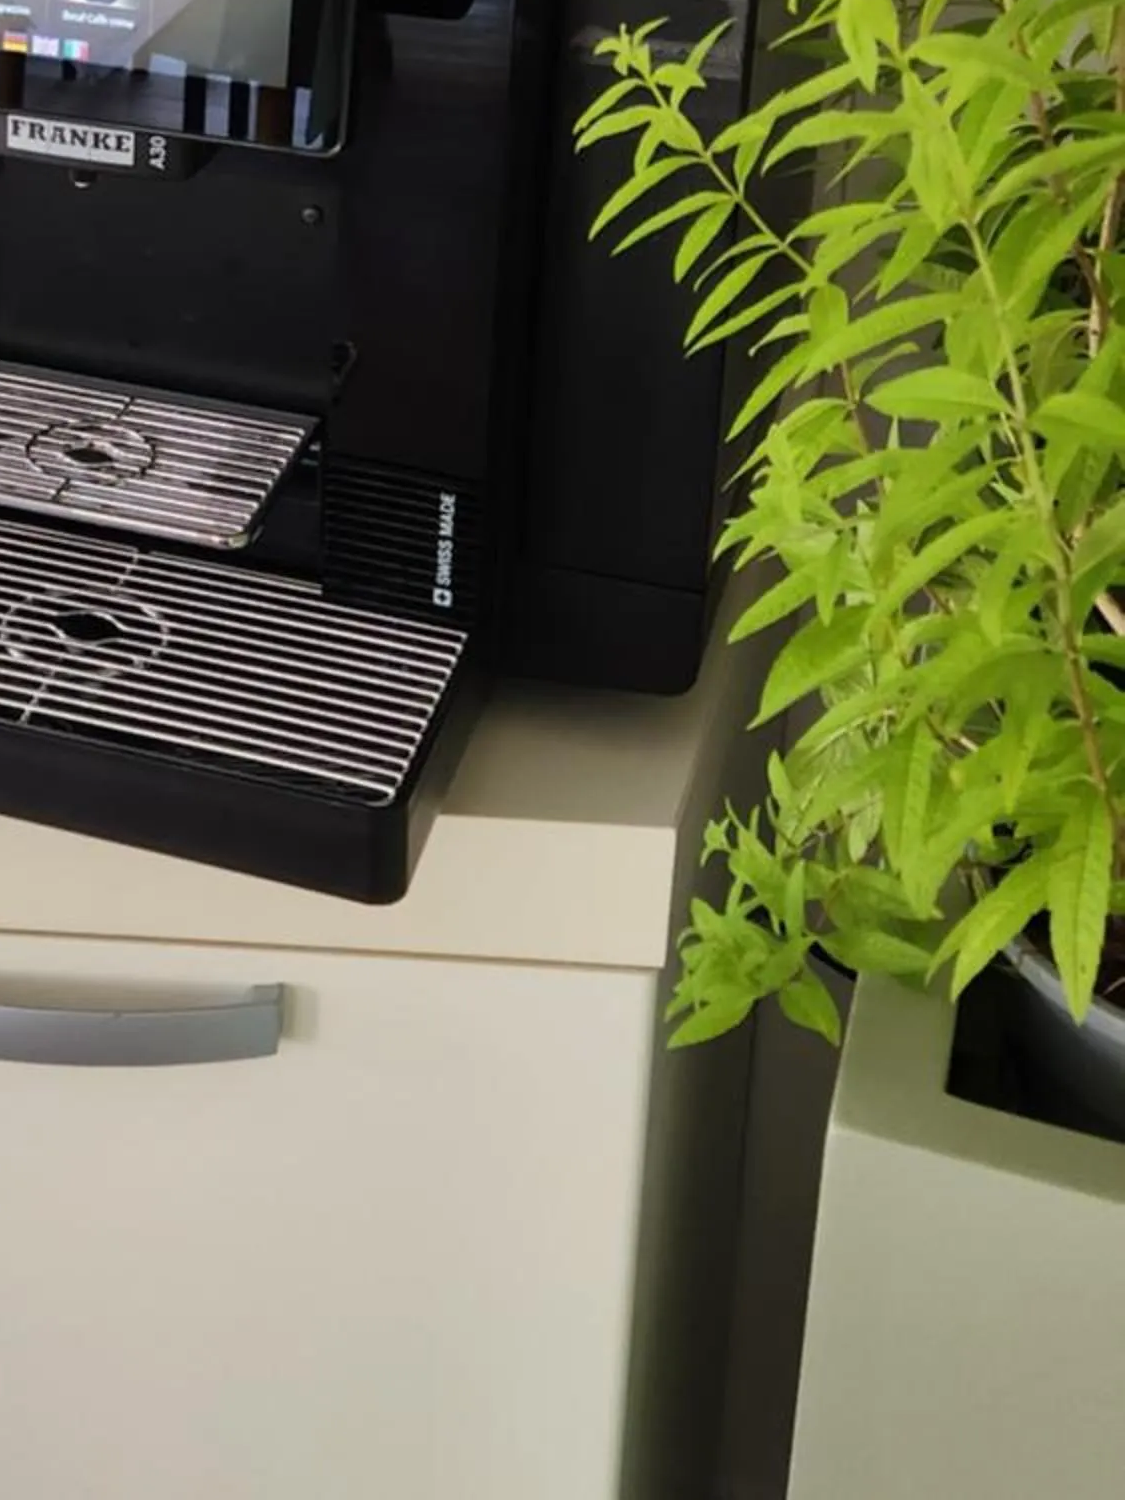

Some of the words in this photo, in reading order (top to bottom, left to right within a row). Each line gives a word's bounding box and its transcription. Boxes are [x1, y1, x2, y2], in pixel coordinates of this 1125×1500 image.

[10, 119, 132, 153] FRANKE
[149, 135, 167, 170] A30
[438, 491, 456, 537] MADE
[436, 539, 454, 587] SWISS
